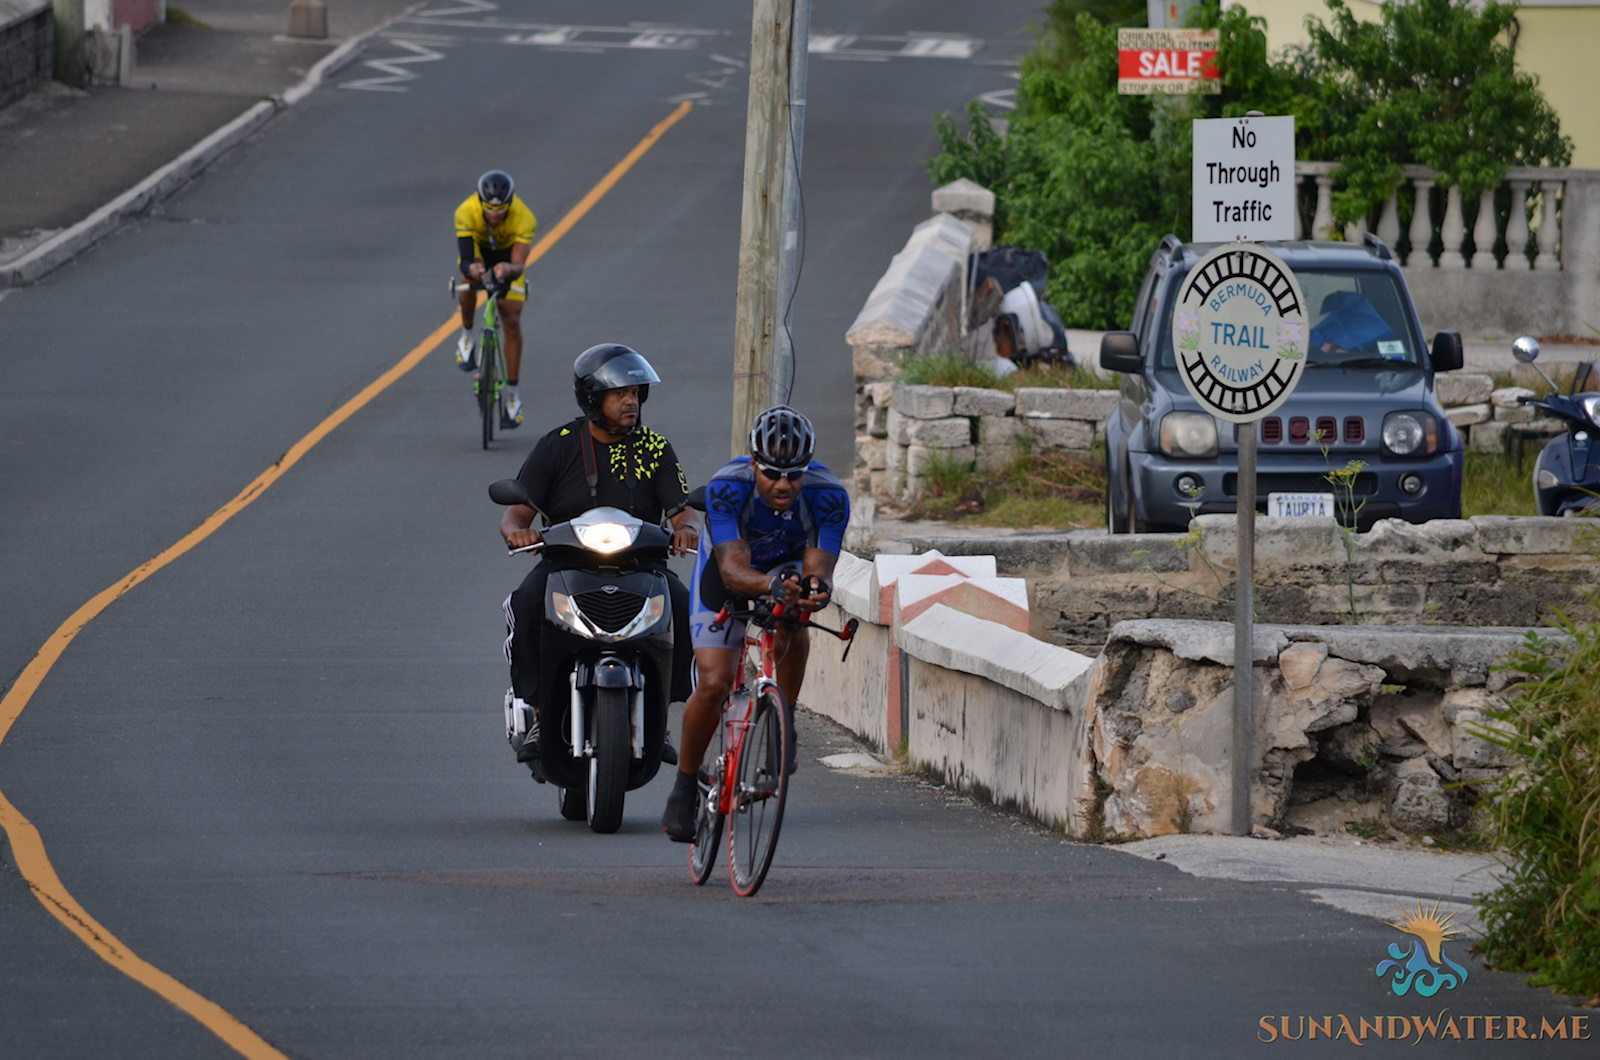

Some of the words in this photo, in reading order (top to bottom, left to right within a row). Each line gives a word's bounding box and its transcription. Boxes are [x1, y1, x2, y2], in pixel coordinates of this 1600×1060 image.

[1120, 31, 1172, 40] ORIENTAL
[1120, 40, 1186, 50] HOUSEHOLD
[1138, 51, 1203, 77] SALE
[1120, 82, 1148, 92] STOP
[1151, 82, 1165, 92] BY
[1167, 82, 1184, 92] OR
[1232, 126, 1257, 149] No
[1206, 160, 1280, 188] Through
[1212, 200, 1272, 223] Traffic
[1209, 283, 1273, 317] BERMUDA
[1210, 322, 1270, 349] TRAIL
[1210, 354, 1265, 383] RAILWAY
